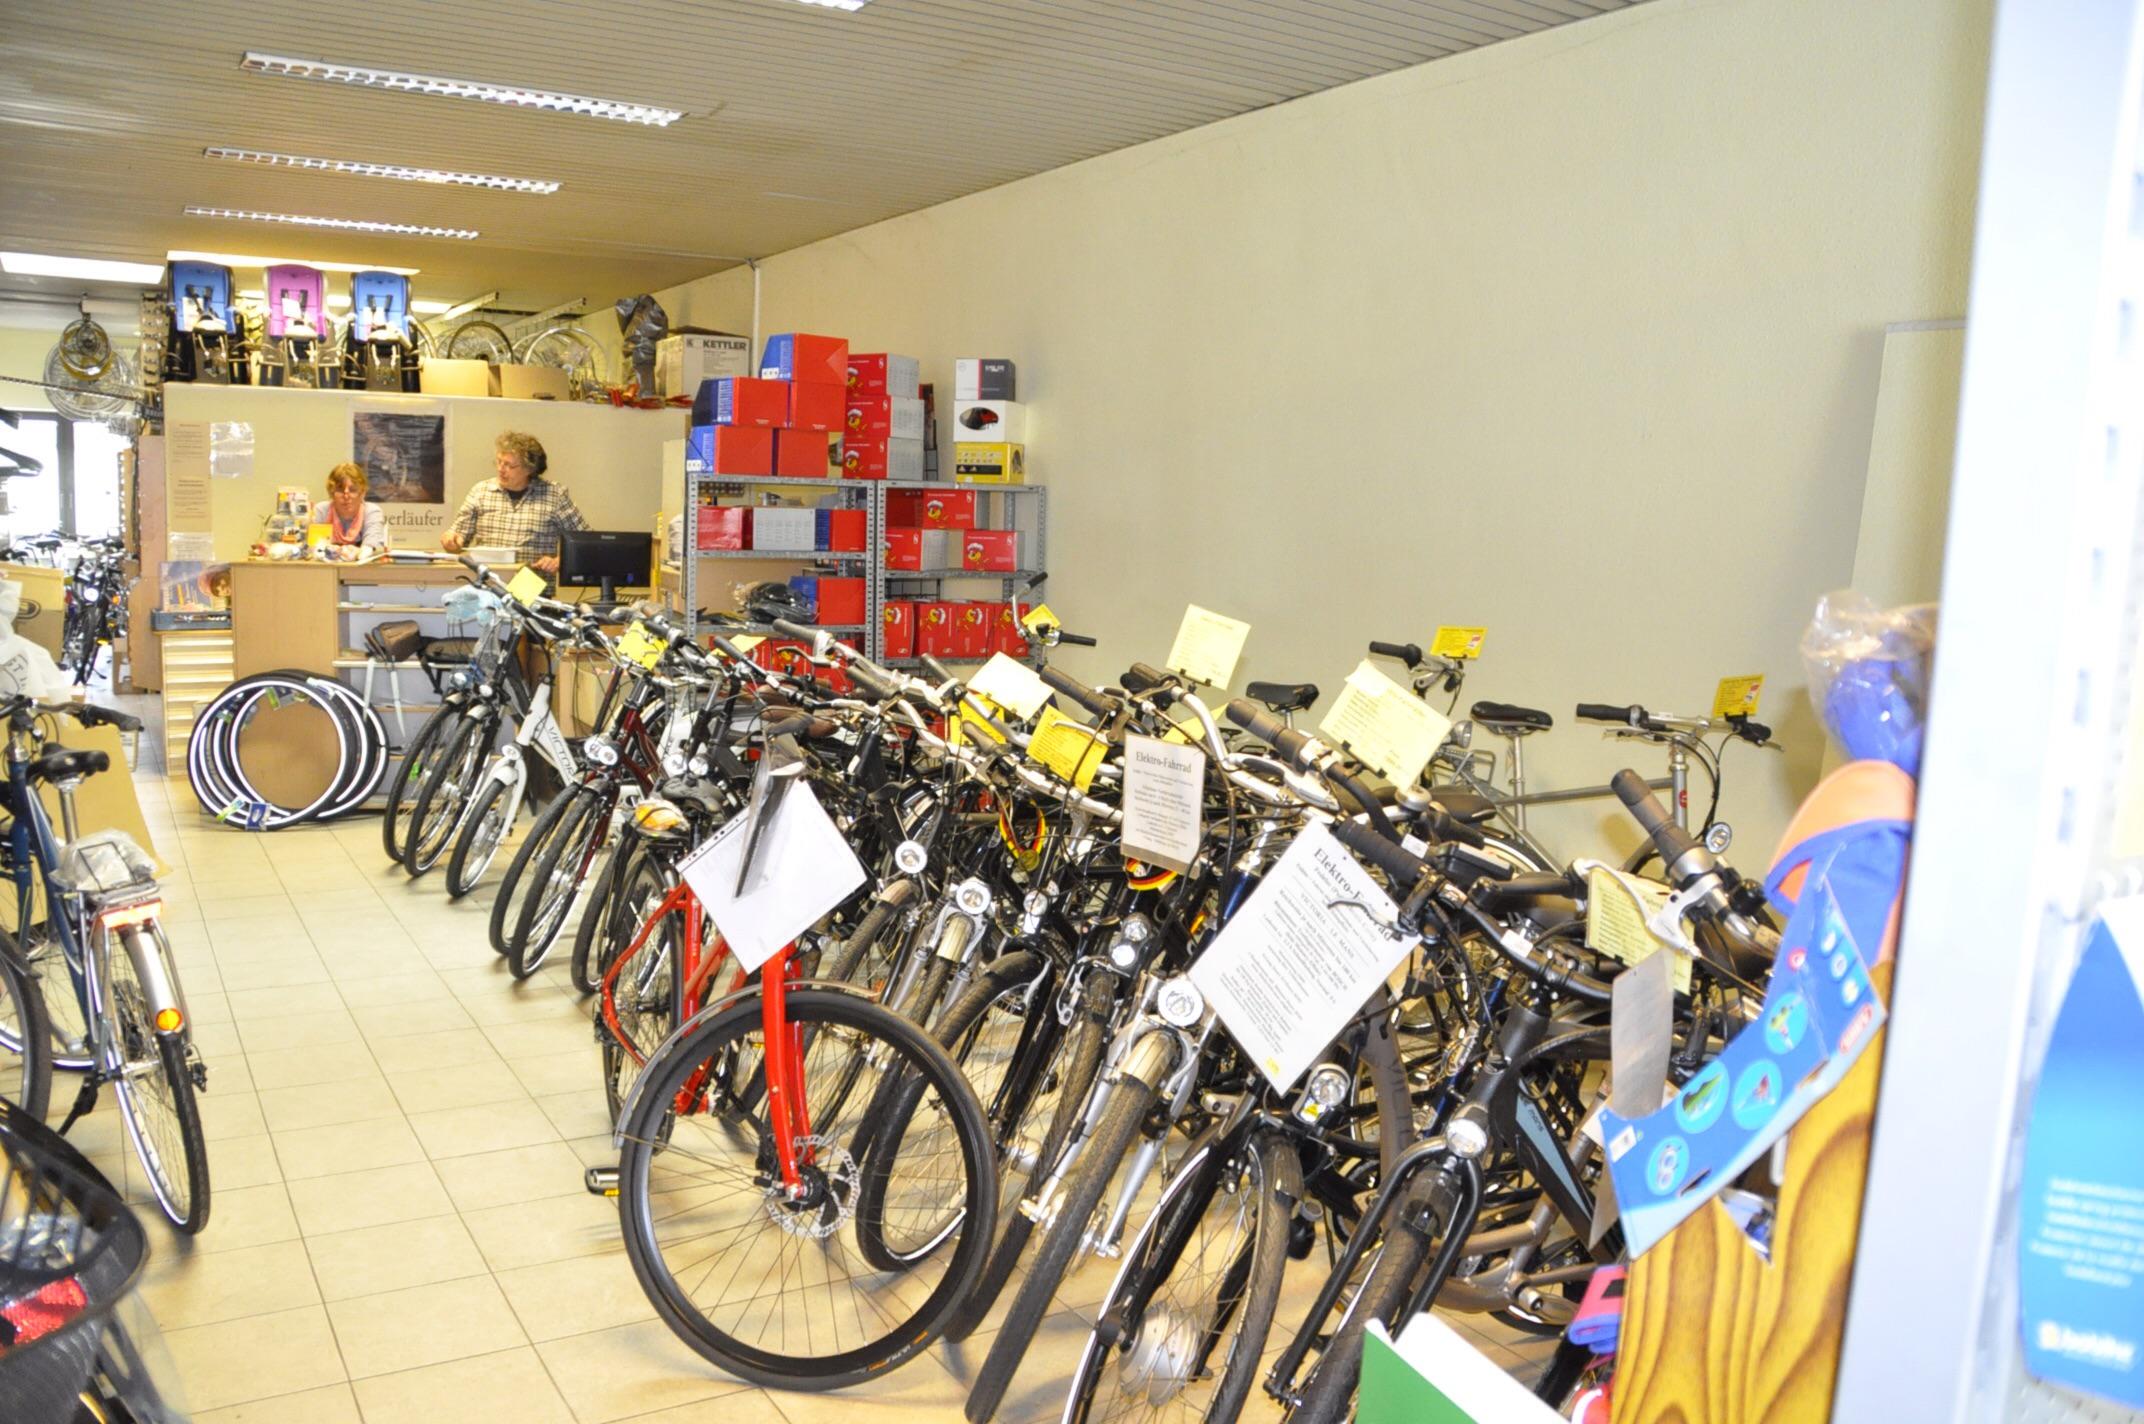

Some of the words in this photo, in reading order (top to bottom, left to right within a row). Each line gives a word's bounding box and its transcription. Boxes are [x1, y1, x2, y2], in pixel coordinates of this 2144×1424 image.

[703, 339, 747, 350] KETTLER
[548, 726, 577, 777] VICTOR
[1136, 751, 1192, 774] Elektro-Fahrrad
[1313, 847, 1393, 942] Elektro-Fad
